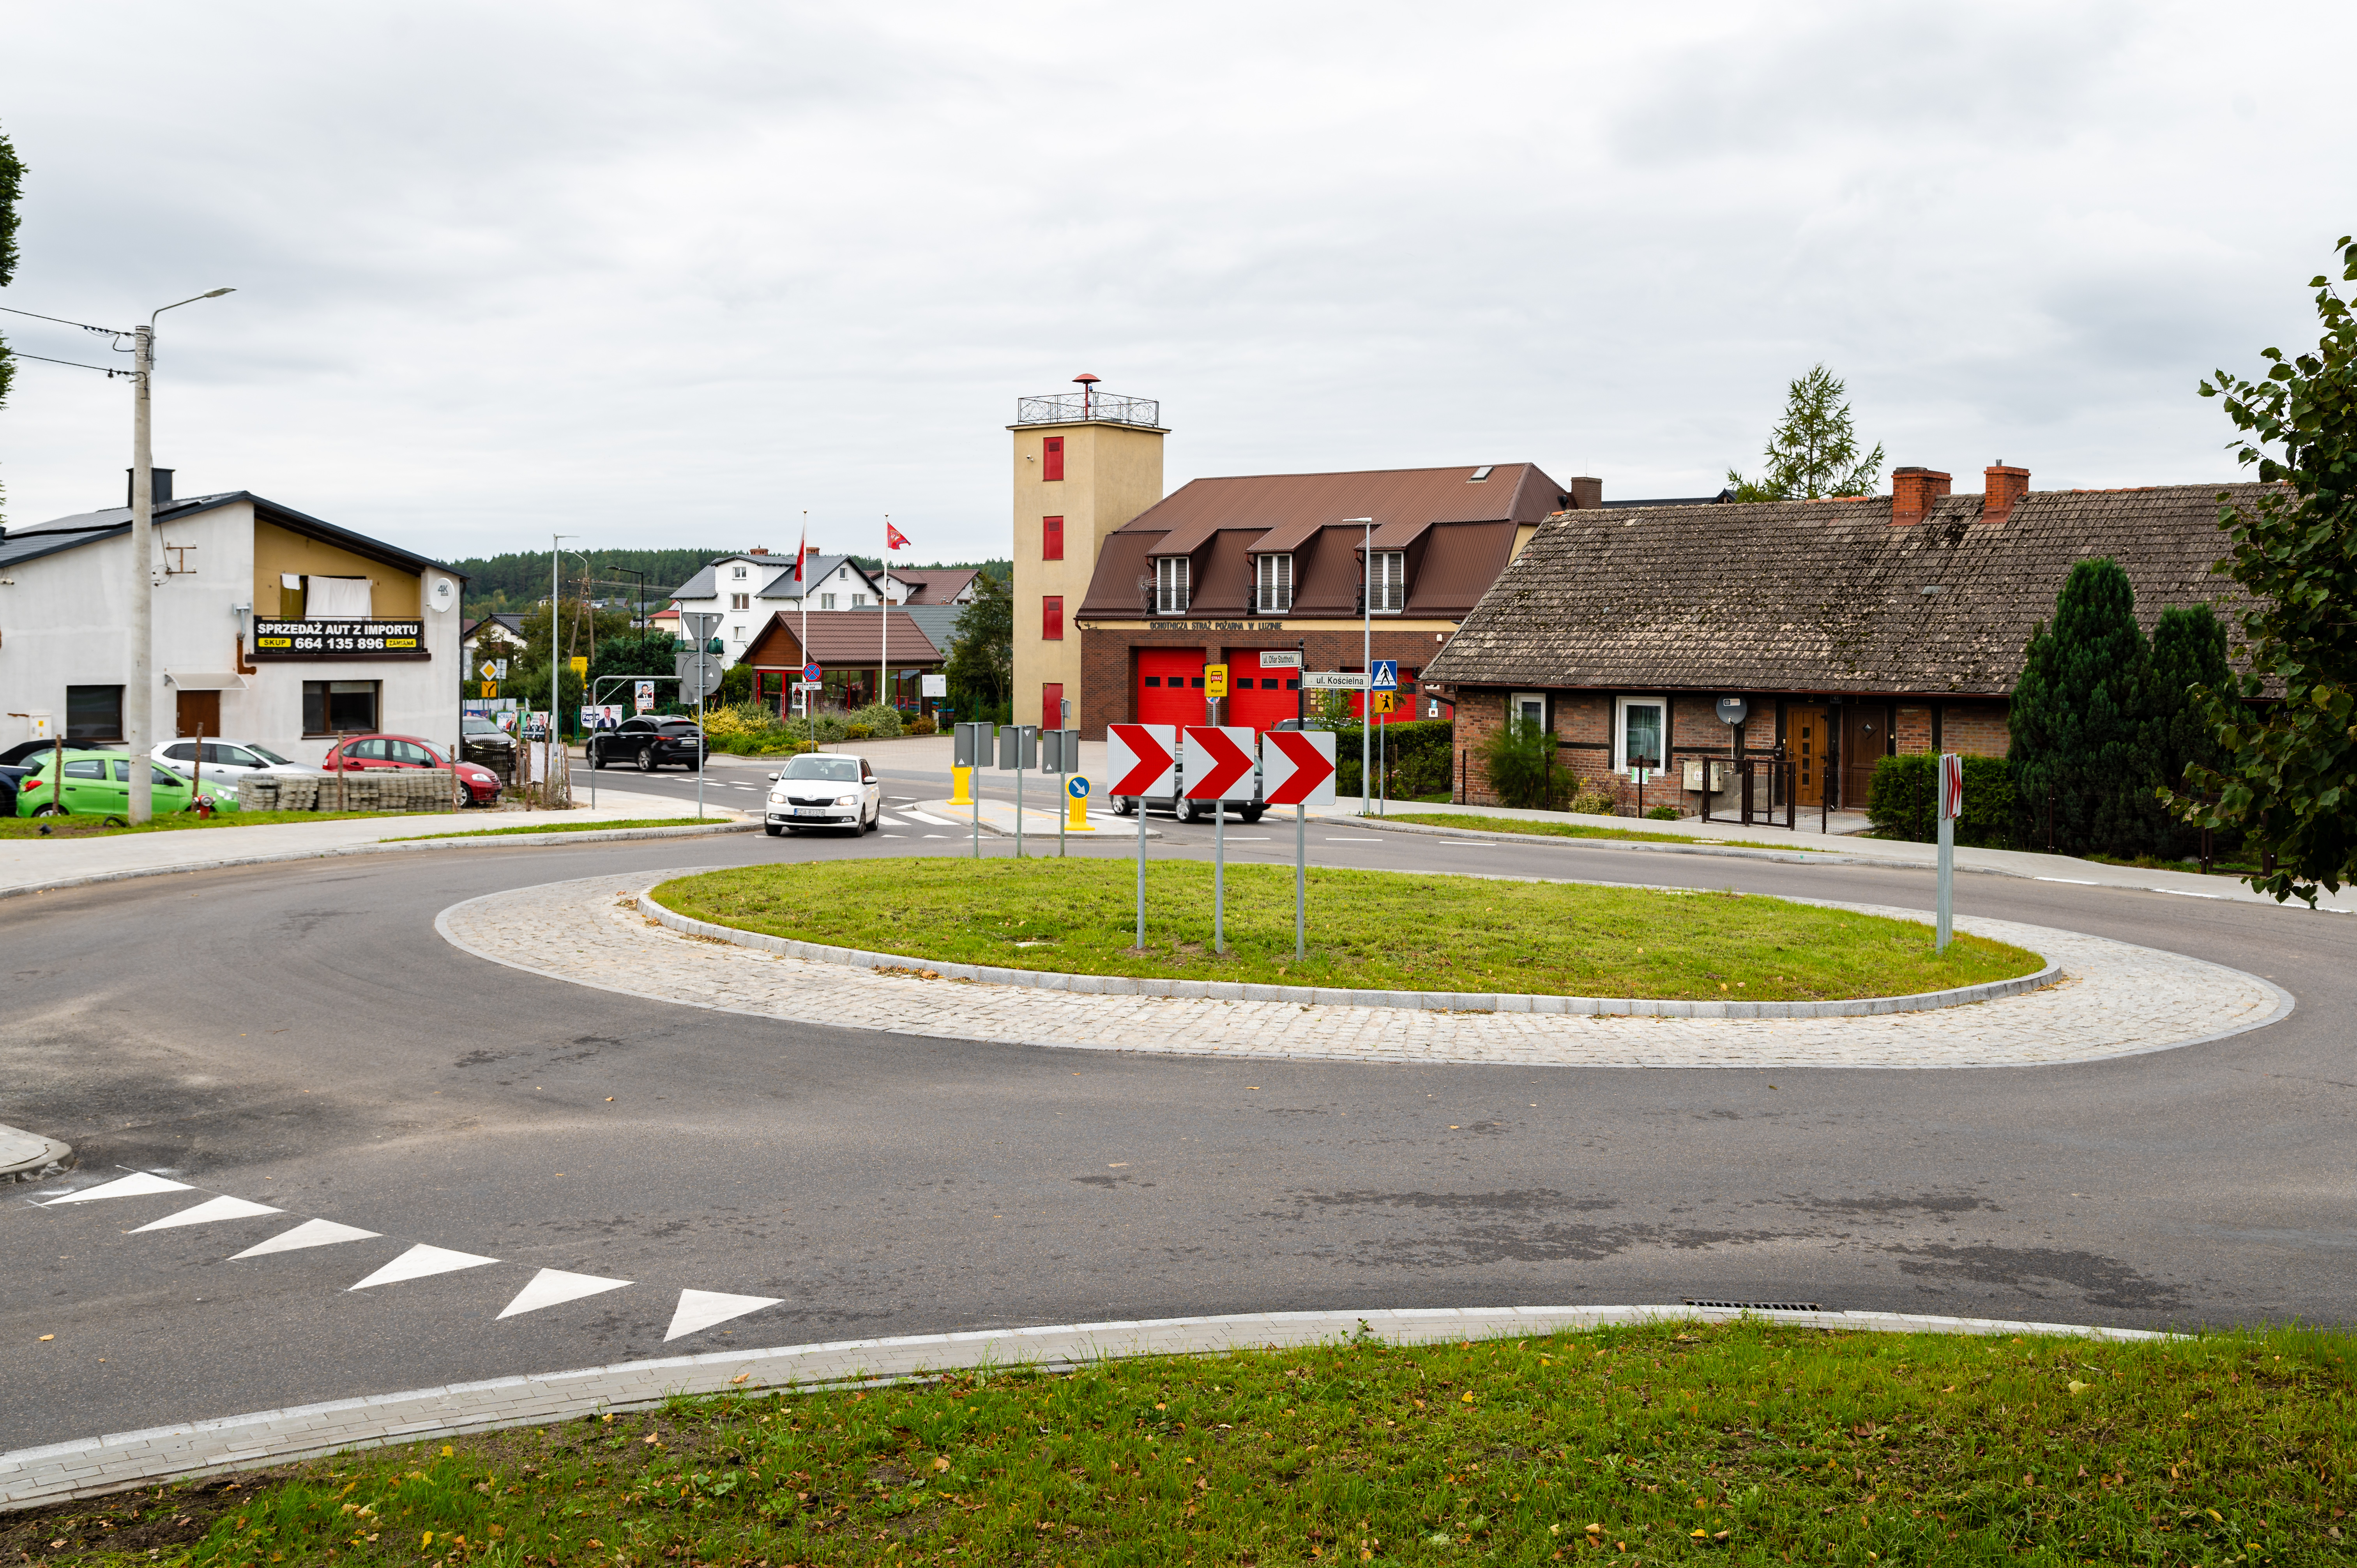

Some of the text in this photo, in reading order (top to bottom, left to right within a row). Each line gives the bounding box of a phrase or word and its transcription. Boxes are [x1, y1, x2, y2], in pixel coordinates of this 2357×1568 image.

[258, 622, 418, 634] SPRZEDAŻ AUT Z IMPORTU
[1192, 620, 1212, 630] STRAŻ
[1215, 620, 1244, 630] POŻARNA
[295, 637, 384, 649] 664 135 896
[1328, 676, 1363, 685] Kościelna
